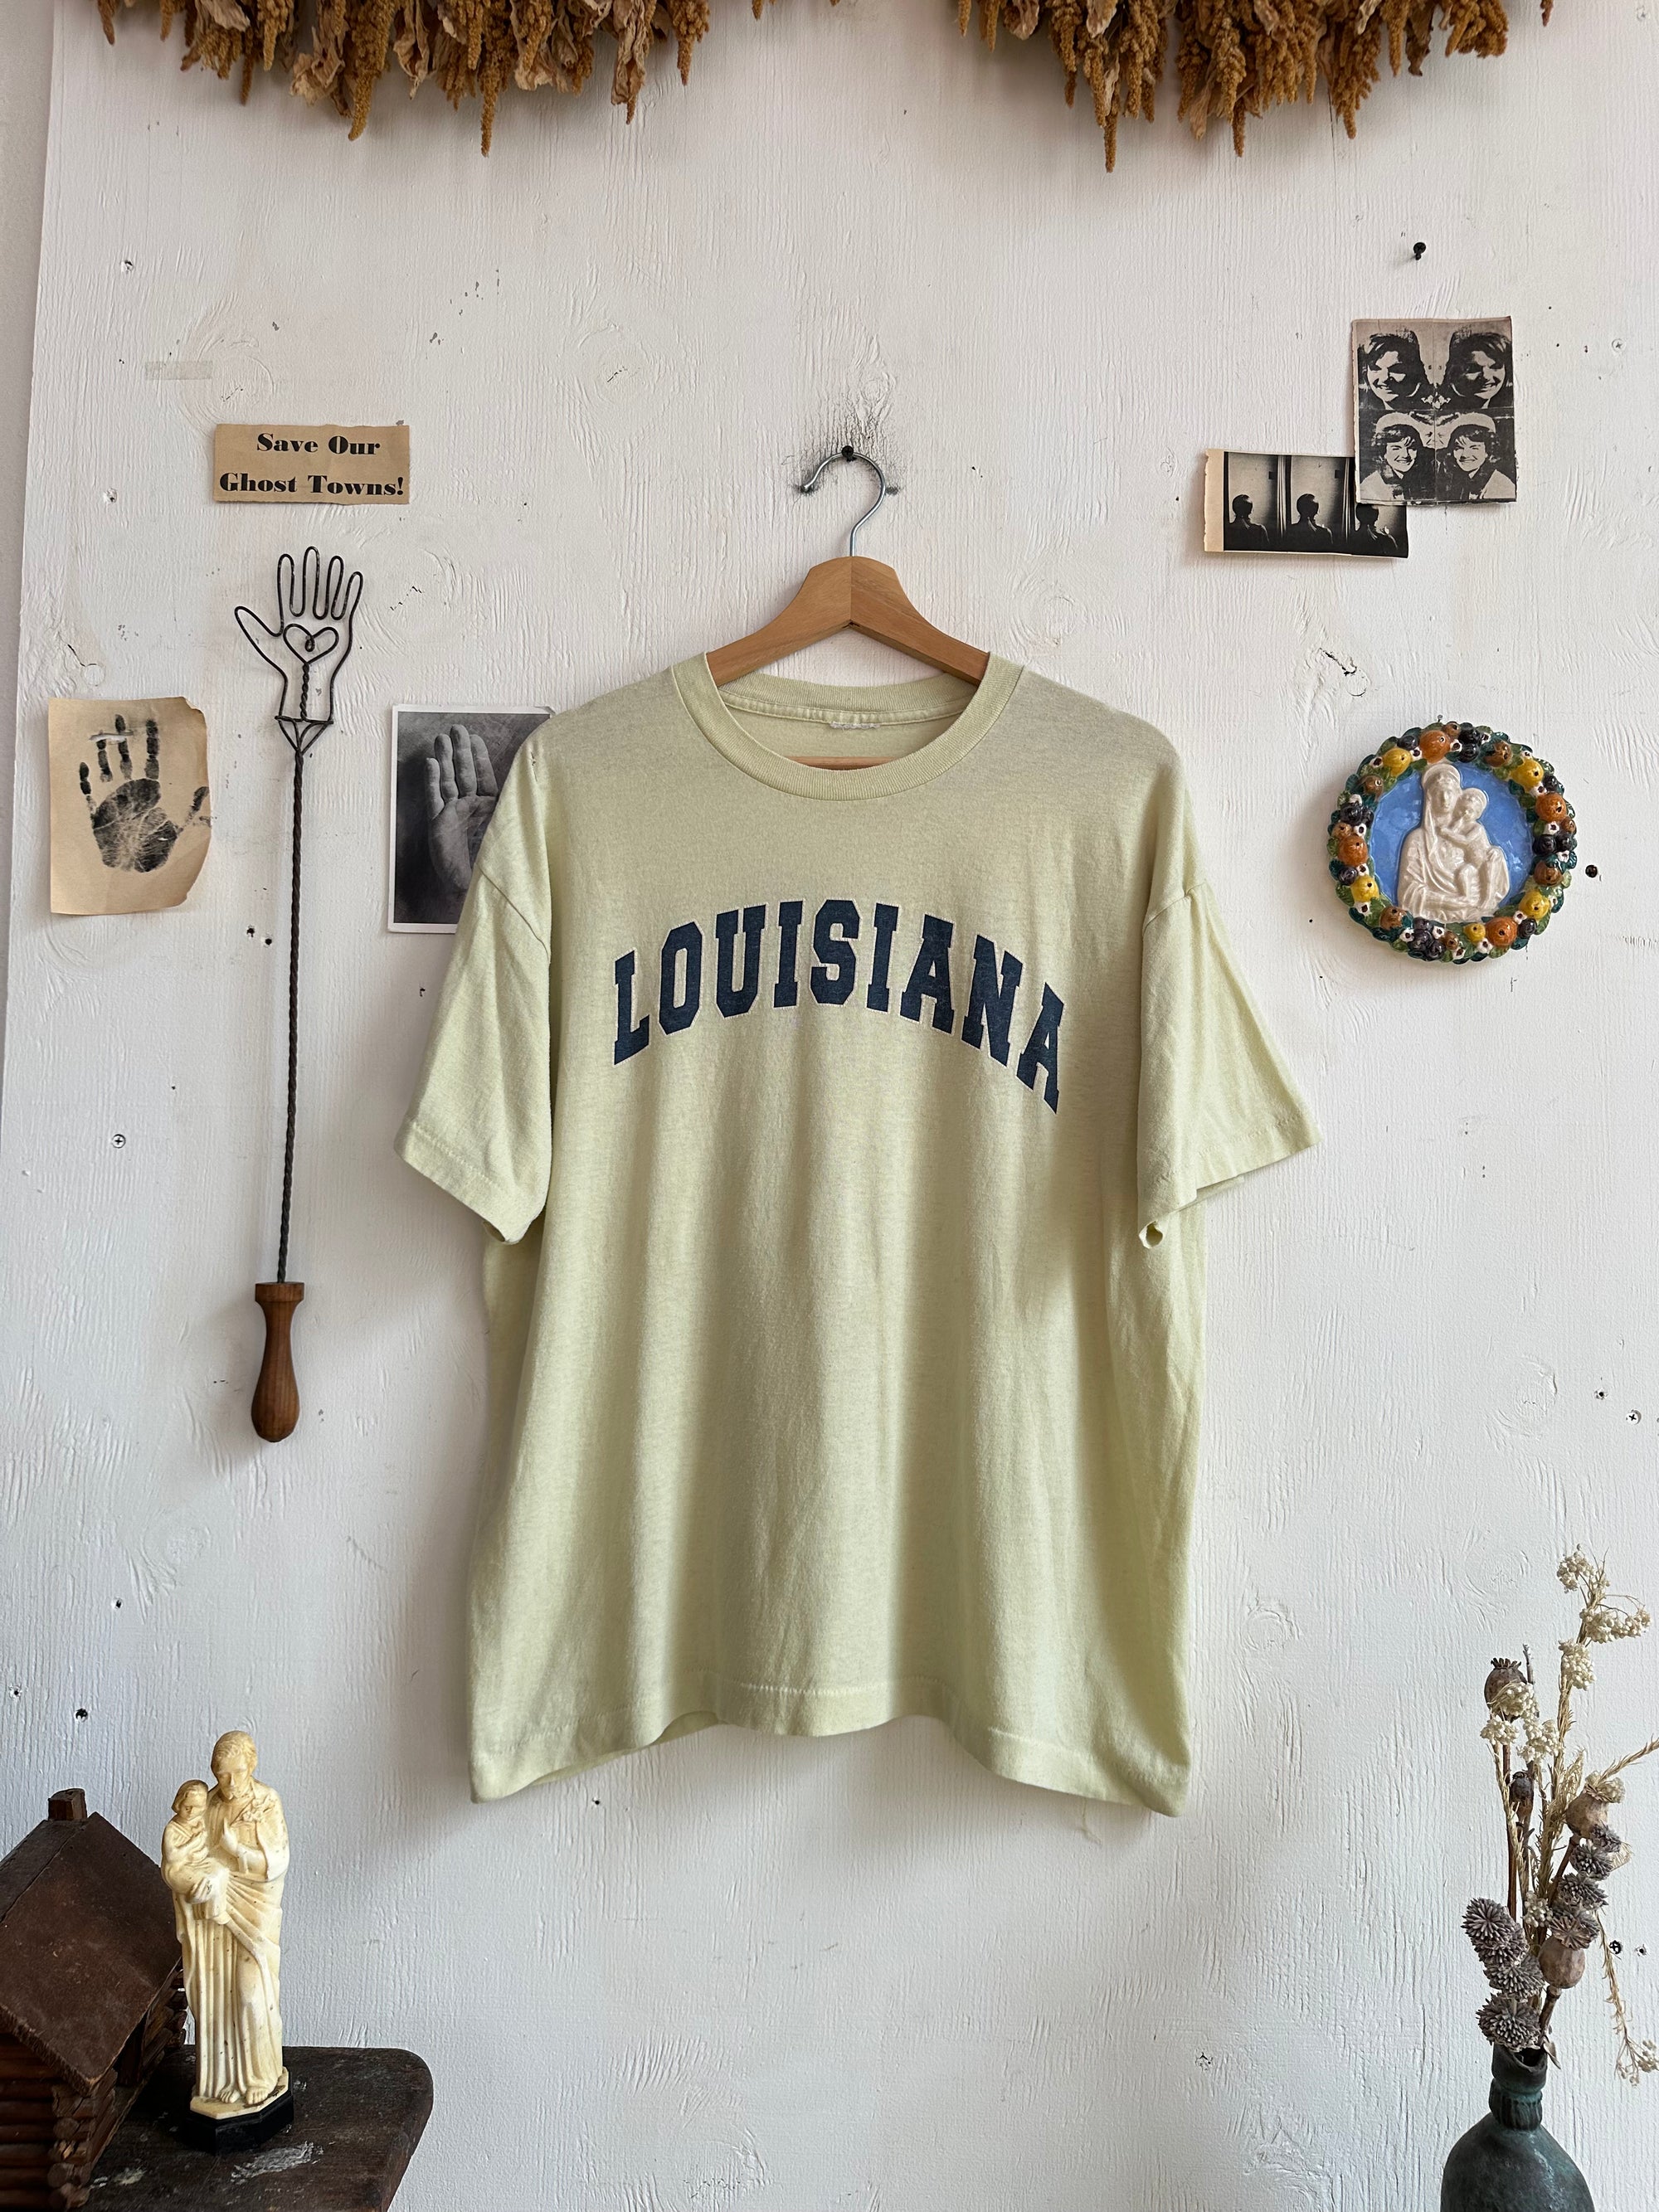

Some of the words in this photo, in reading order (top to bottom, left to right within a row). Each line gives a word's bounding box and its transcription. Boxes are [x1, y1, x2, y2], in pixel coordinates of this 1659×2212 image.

[256, 432, 319, 454] Save
[328, 435, 381, 455] Our
[219, 472, 297, 493] Ghost
[307, 474, 405, 496] Towns!
[612, 898, 1065, 1116] LOUISIANA
